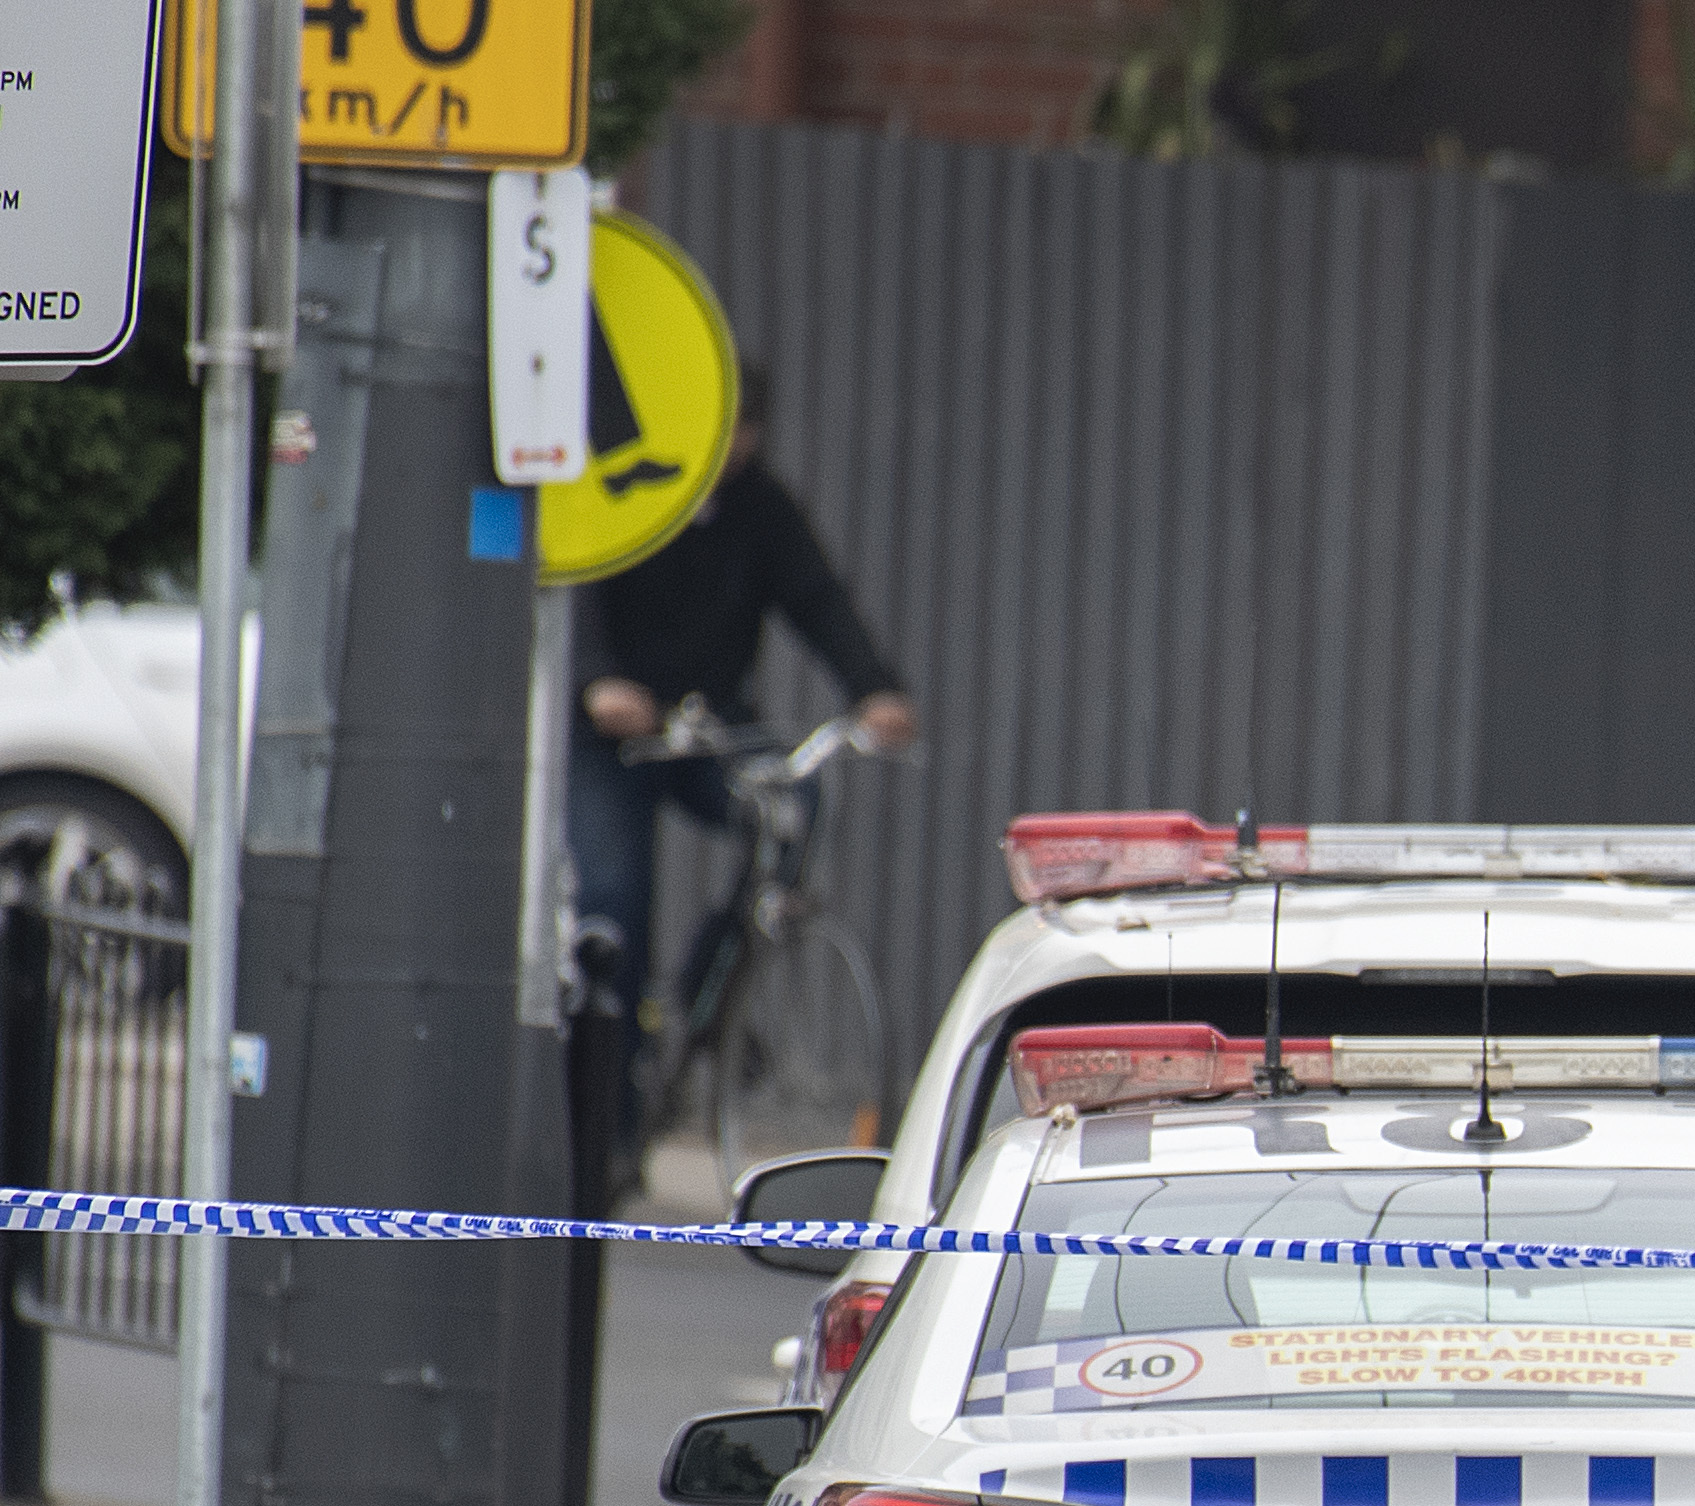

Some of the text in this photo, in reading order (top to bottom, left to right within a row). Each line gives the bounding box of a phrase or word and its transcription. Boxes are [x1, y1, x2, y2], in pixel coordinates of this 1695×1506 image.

[301, 78, 469, 137] m/h
[0, 189, 20, 210] M
[1229, 1328, 1498, 1348] STATIONARY
[1102, 1353, 1177, 1382] 40
[1268, 1348, 1679, 1367] LIGHTS FLASHING?
[1297, 1366, 1647, 1387] SLOW TO 40KPH
